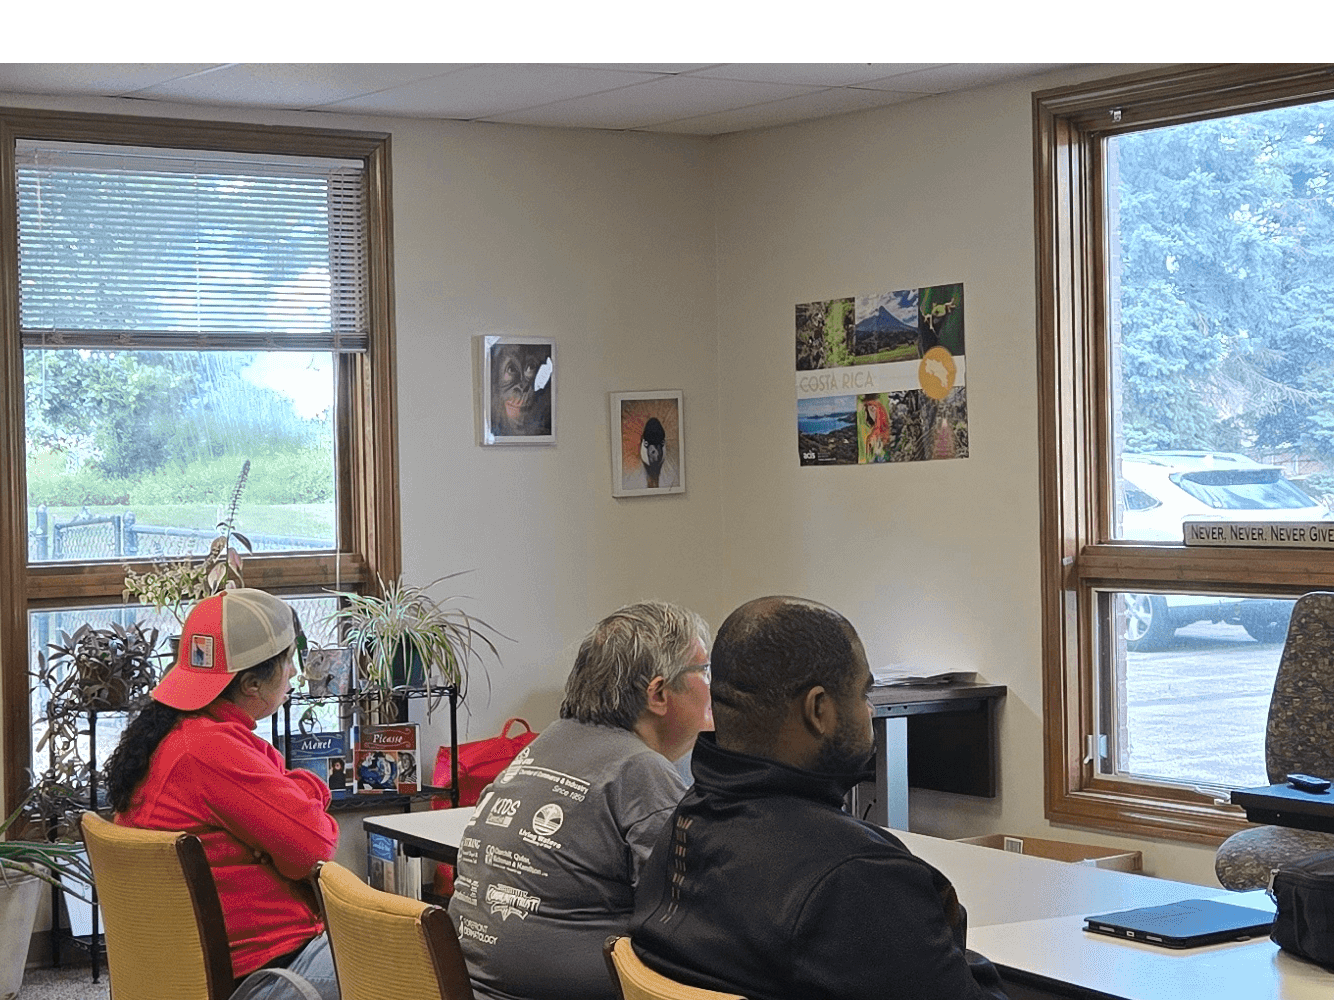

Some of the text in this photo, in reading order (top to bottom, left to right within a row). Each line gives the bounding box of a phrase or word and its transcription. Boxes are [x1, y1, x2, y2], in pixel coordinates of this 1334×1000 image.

[799, 371, 875, 393] COSTA RICA
[1270, 525, 1307, 542] NEVER
[1309, 526, 1334, 542] GIVE
[300, 738, 332, 751] Monet
[551, 784, 570, 797] Since
[490, 797, 521, 816] KIDS
